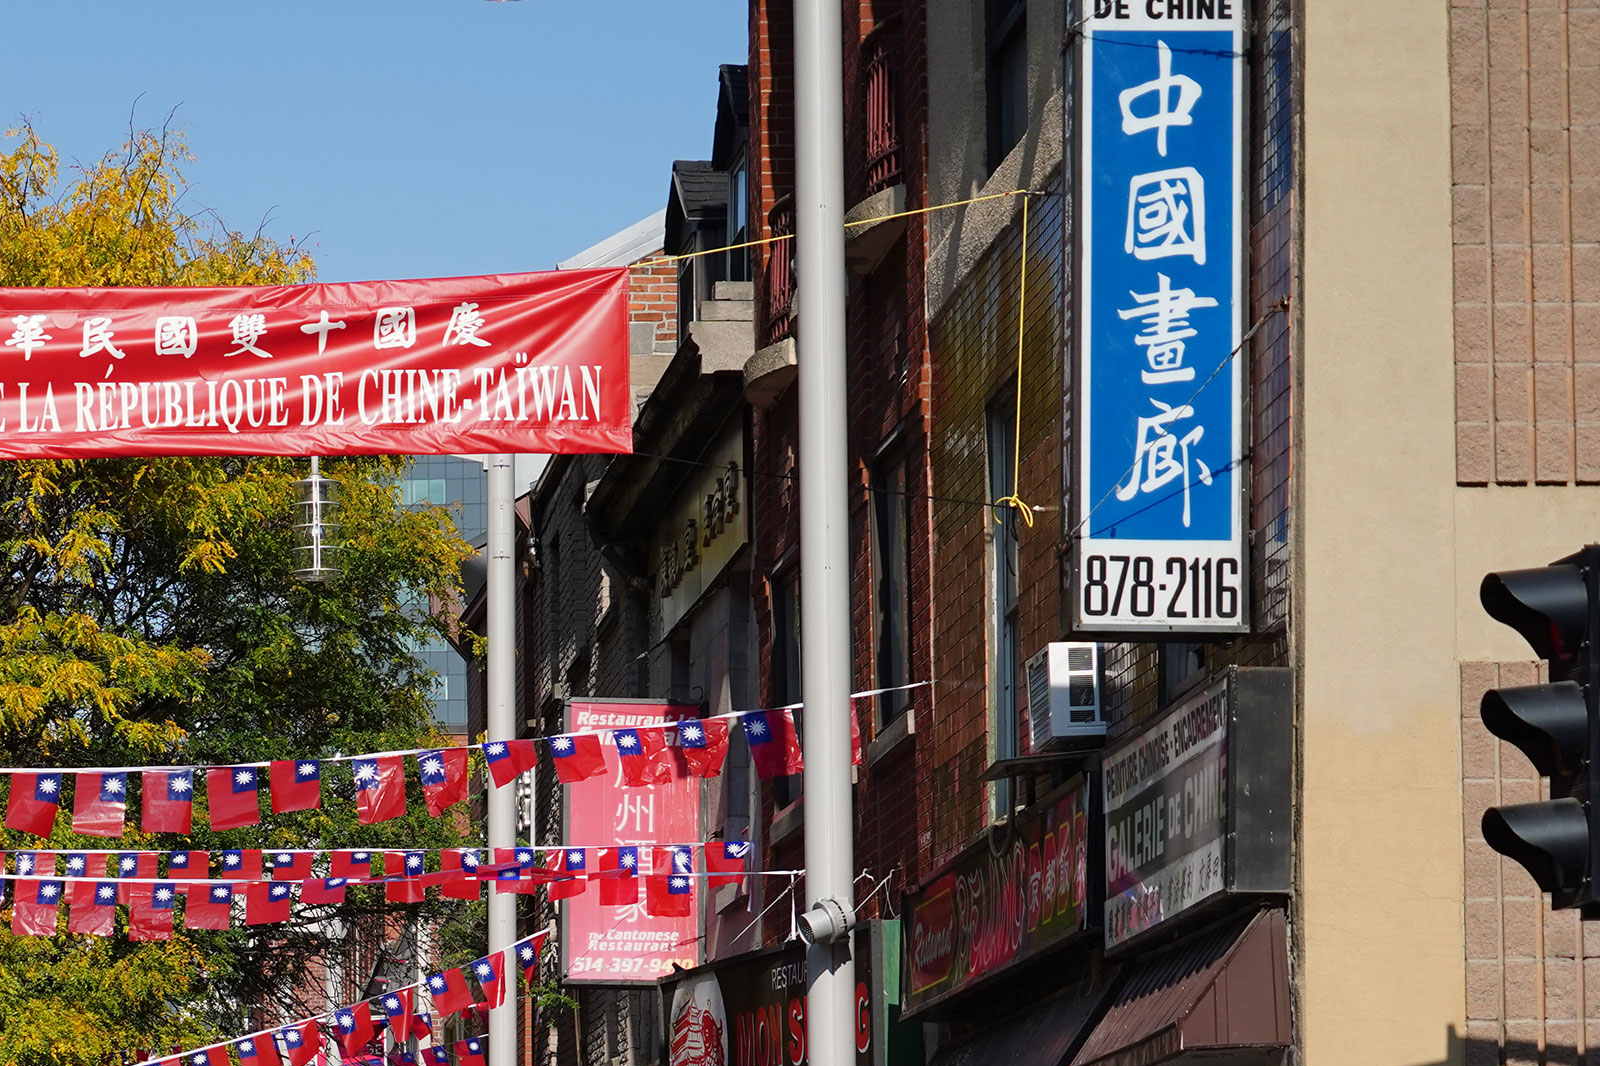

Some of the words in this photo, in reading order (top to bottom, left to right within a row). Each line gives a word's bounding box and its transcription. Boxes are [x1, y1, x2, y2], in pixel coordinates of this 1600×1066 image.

[1094, 0, 1130, 19] DE
[1145, 0, 1233, 20] CHINE
[1117, 40, 1219, 528] 中國畫廊
[18, 381, 62, 434] LA
[75, 364, 289, 434] RÉPUBLIQUE
[300, 371, 344, 427] DE
[357, 352, 603, 425] CHINE-TAÏWAN
[577, 711, 675, 727] Restaurant
[1106, 750, 1138, 802] PEINTURE
[1138, 731, 1170, 782] CHINOISE
[1108, 795, 1164, 883] GALERIE
[1168, 792, 1180, 839] DE
[1184, 754, 1227, 839] CHINE
[588, 942, 678, 953] Restaurant
[607, 930, 679, 942] Cantonese
